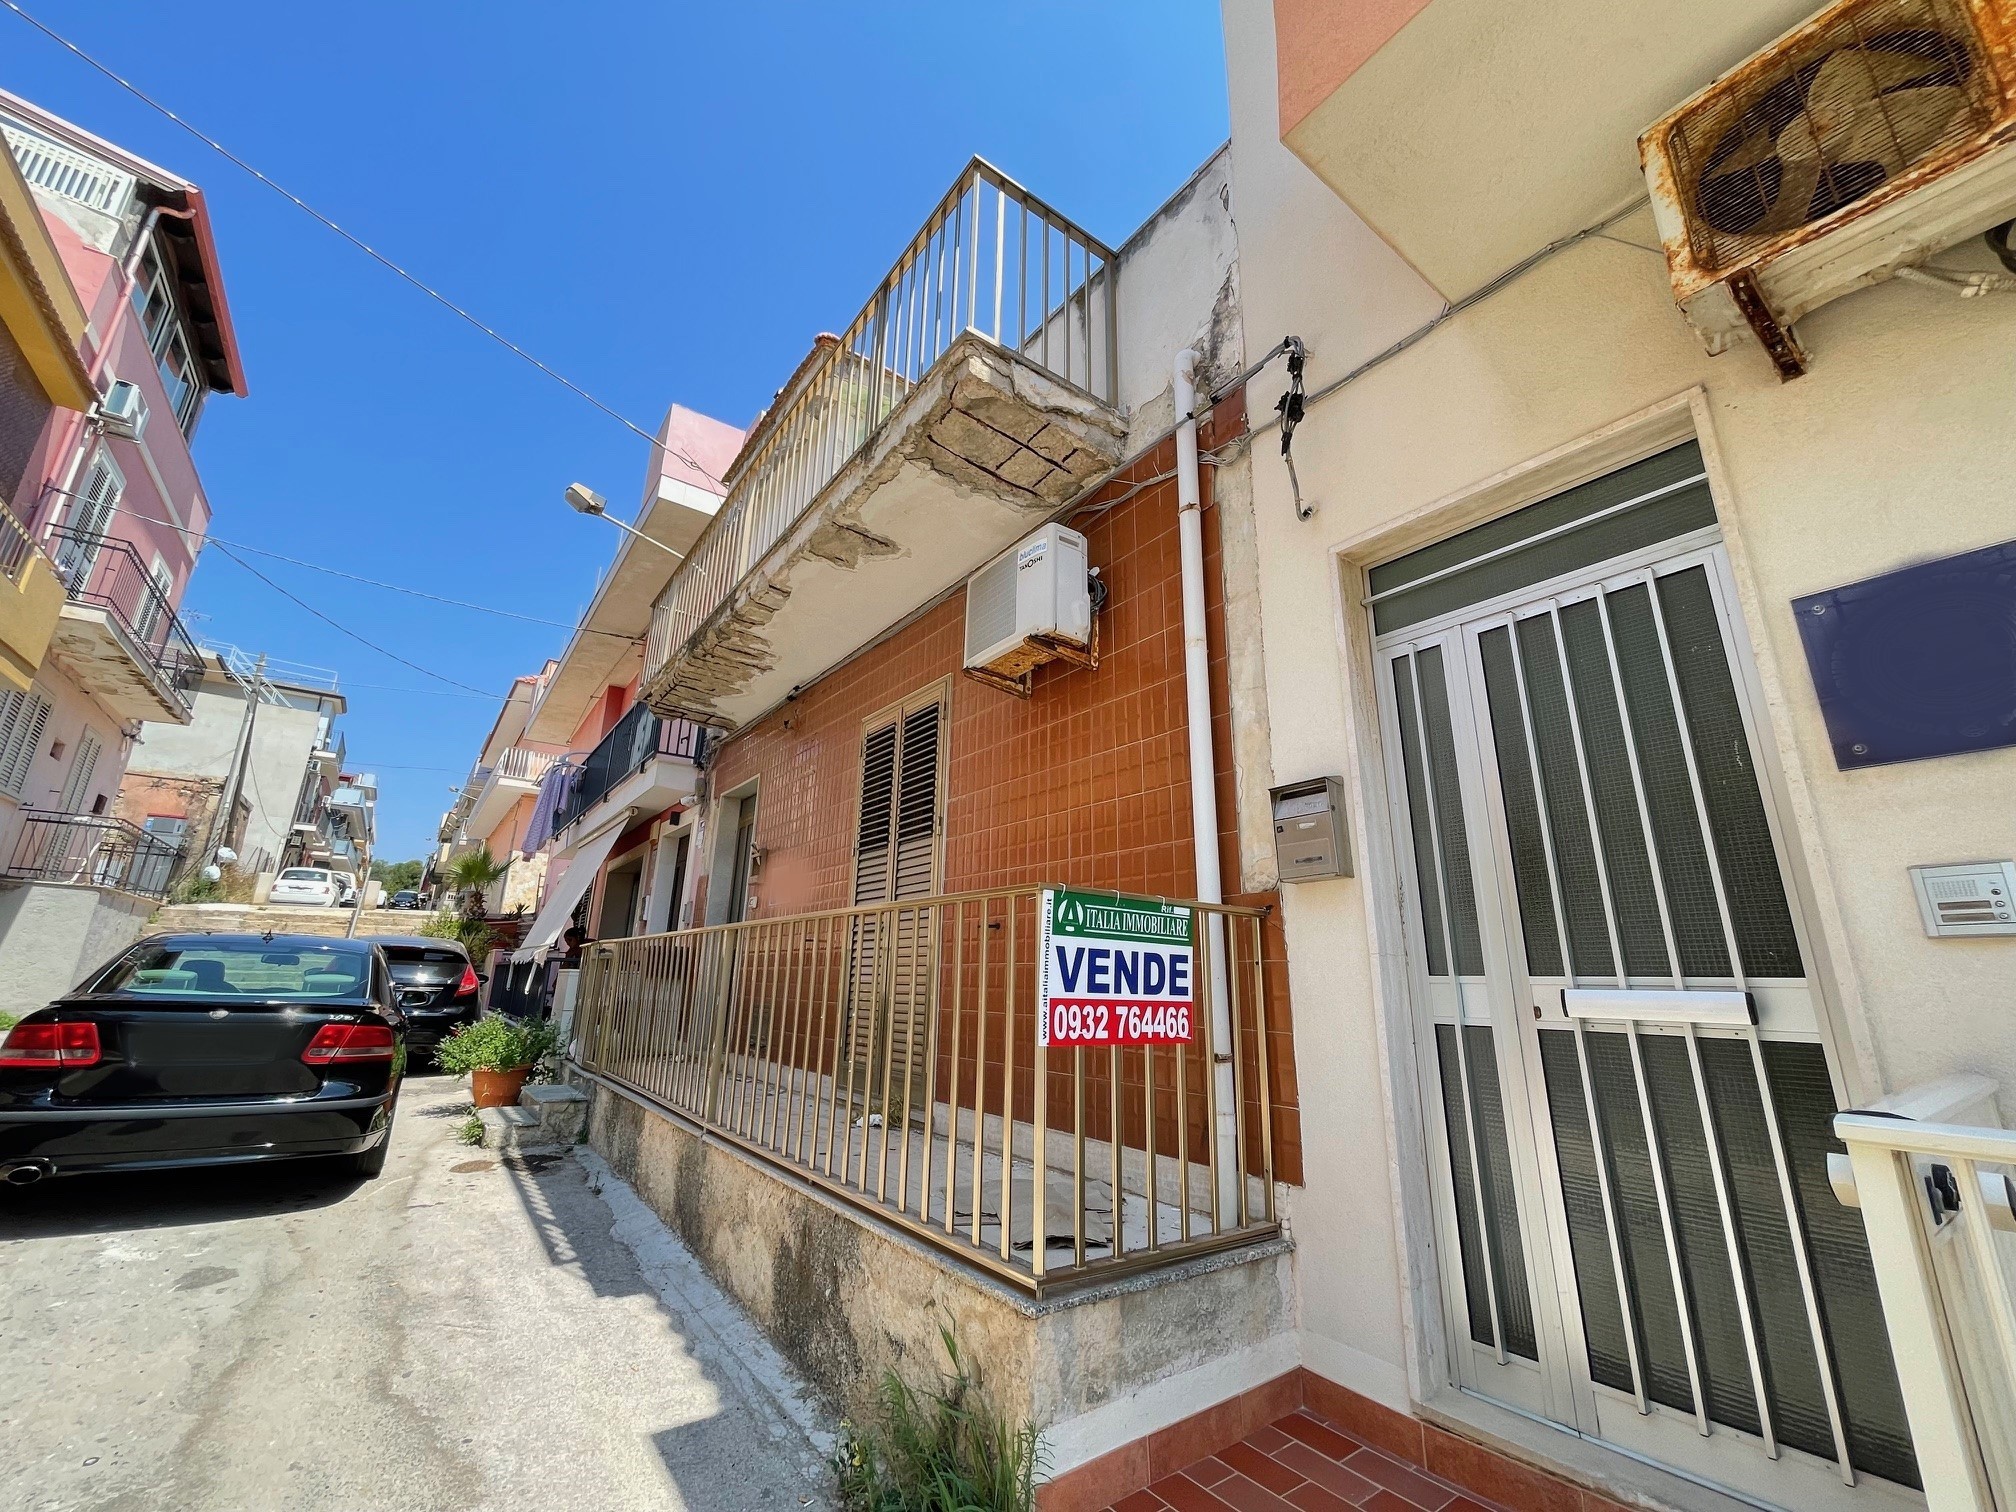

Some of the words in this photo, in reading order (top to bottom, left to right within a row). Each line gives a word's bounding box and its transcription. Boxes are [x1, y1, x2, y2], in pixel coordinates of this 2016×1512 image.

[1086, 909, 1121, 930] ITALIA
[1122, 913, 1188, 936] IMMOBILIARE
[1042, 898, 1052, 1040] www.aitaliaimmobiliare.it
[1055, 945, 1189, 996] VENDE
[1053, 1004, 1109, 1040] 0932
[1115, 1005, 1190, 1039] 764466
